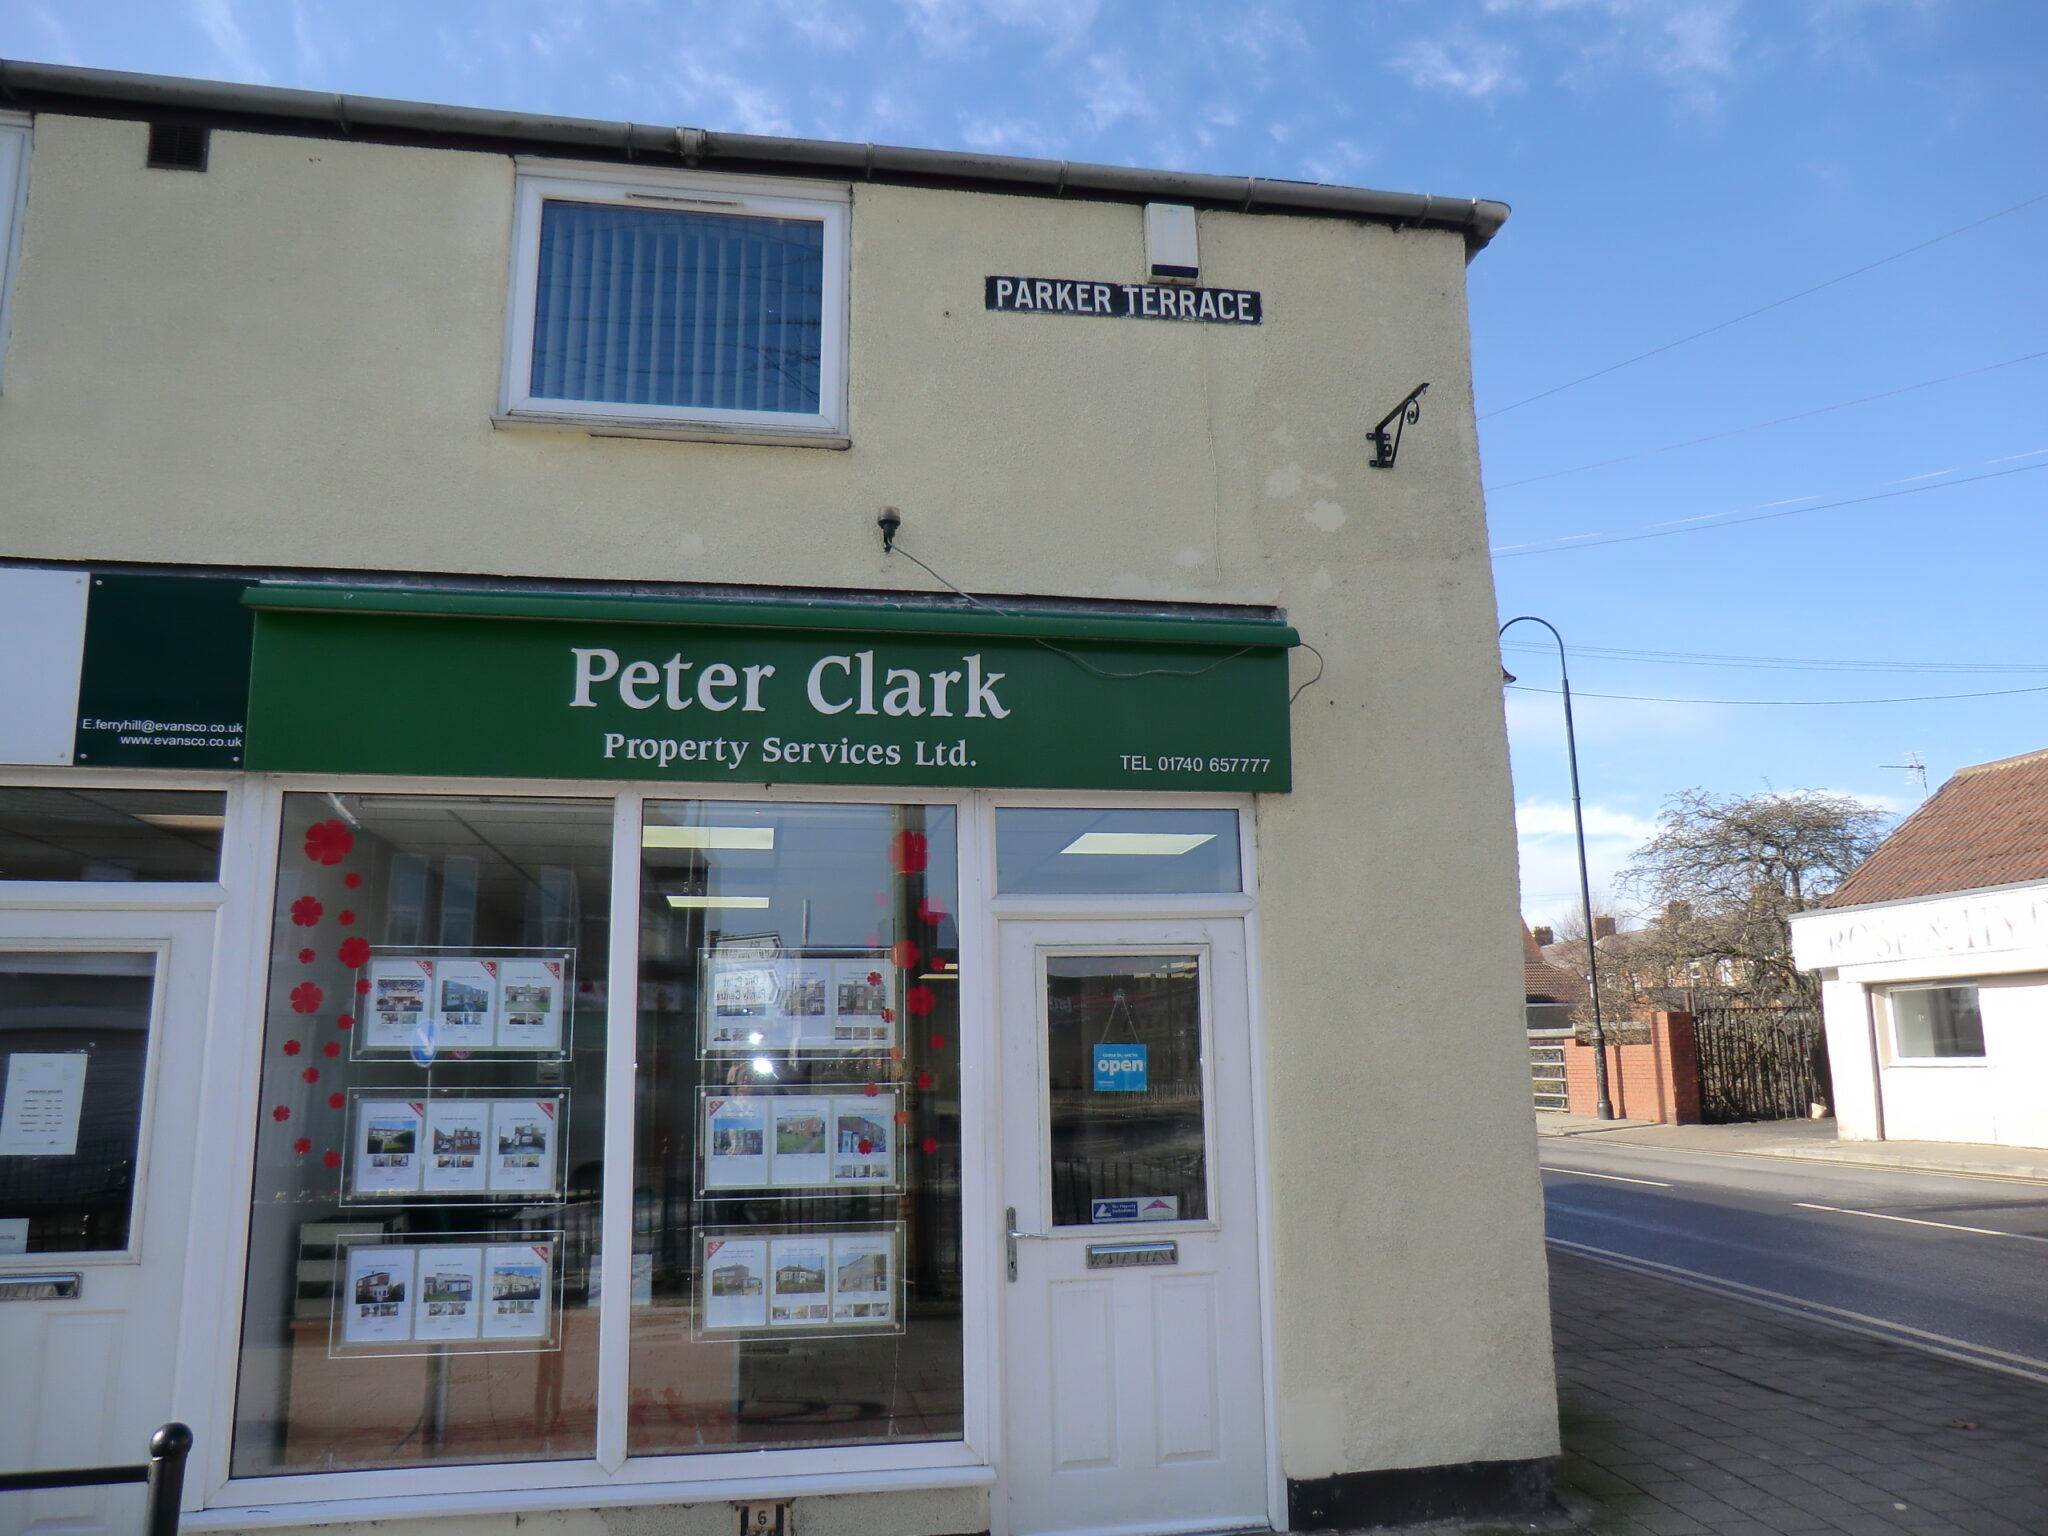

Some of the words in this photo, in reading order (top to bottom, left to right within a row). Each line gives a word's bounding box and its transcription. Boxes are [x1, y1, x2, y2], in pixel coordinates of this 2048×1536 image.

[996, 279, 1112, 313] PARKER
[1122, 286, 1254, 321] TERRACE
[569, 647, 776, 712] Peter
[806, 649, 1011, 720] Clark
[82, 718, 243, 733] E.ferryhill@evansco.co.uk
[120, 735, 242, 747] www.evansco.co.uk
[603, 733, 750, 770] Property
[762, 736, 901, 765] Services
[914, 739, 977, 767] Ltd.
[1119, 755, 1152, 771] TEL
[1158, 756, 1203, 772] 01740
[1209, 757, 1270, 773] 657777
[1098, 1059, 1144, 1076] open
[757, 1510, 767, 1525] 6
